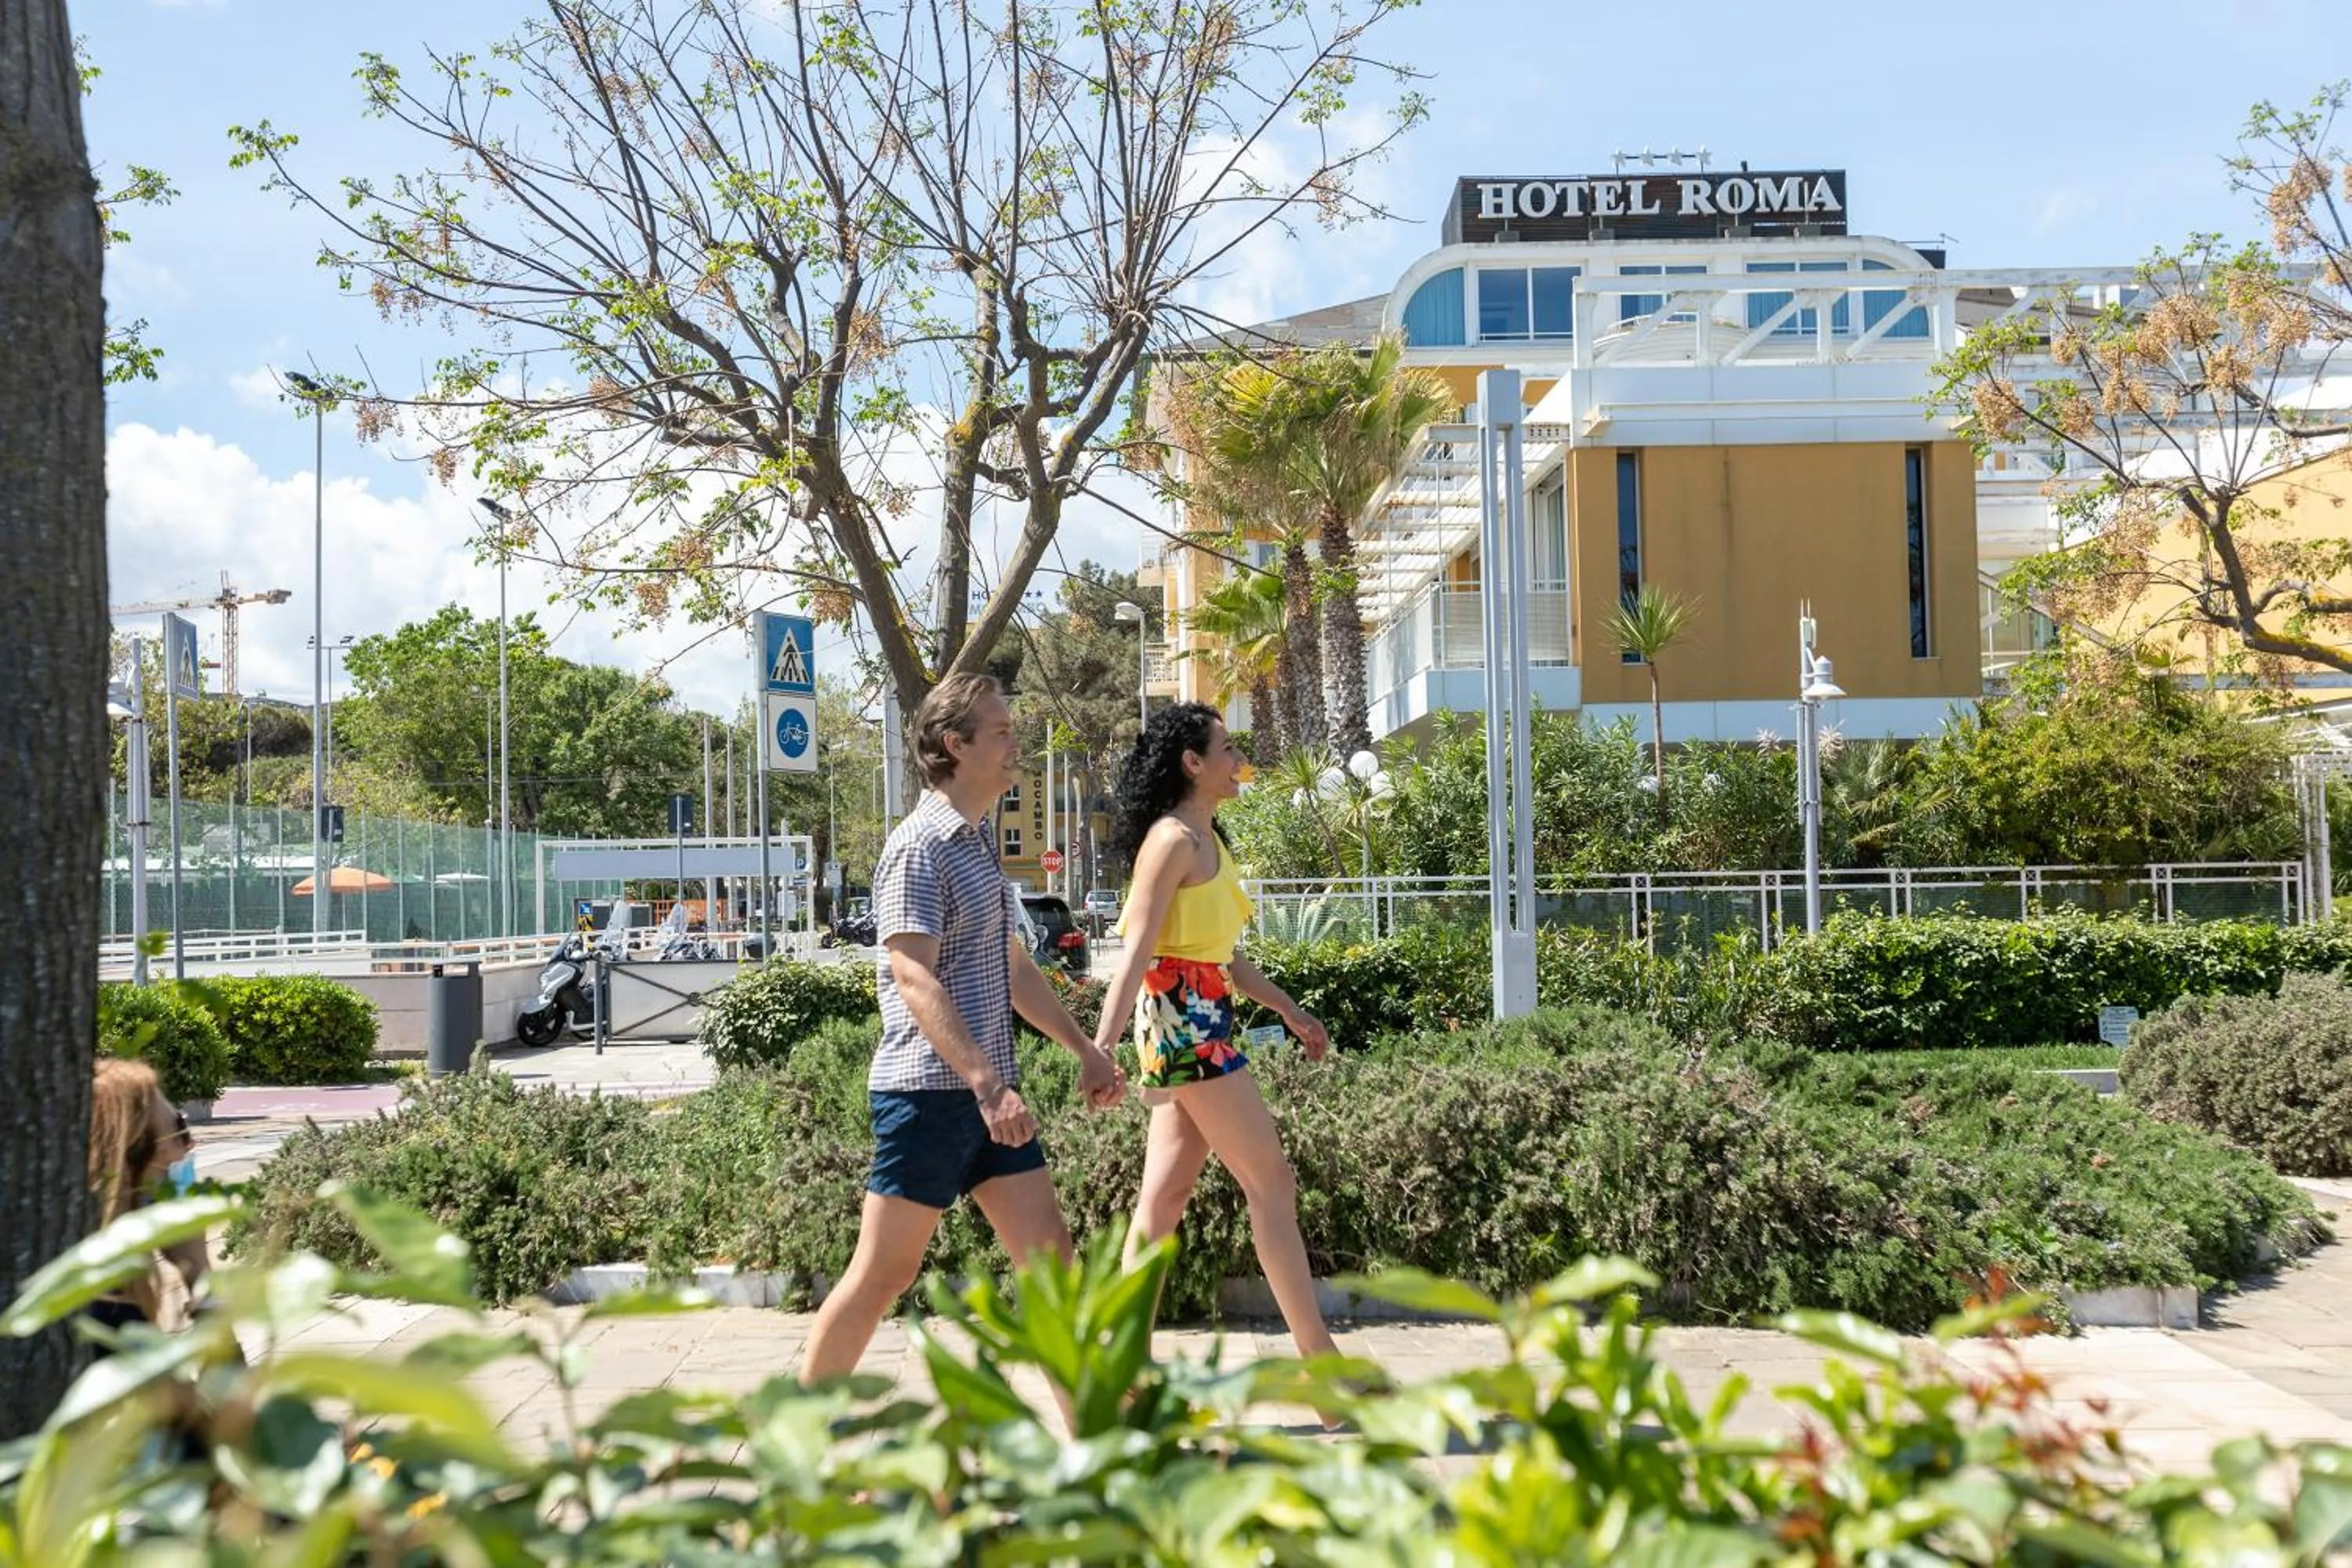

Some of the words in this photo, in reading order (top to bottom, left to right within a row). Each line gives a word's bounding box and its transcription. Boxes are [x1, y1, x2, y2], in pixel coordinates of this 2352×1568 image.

[1477, 180, 1661, 219] HOTEL
[1677, 176, 1842, 215] ROMA
[1033, 770, 1043, 840] MOCAMBO
[1043, 857, 1062, 866] STOP
